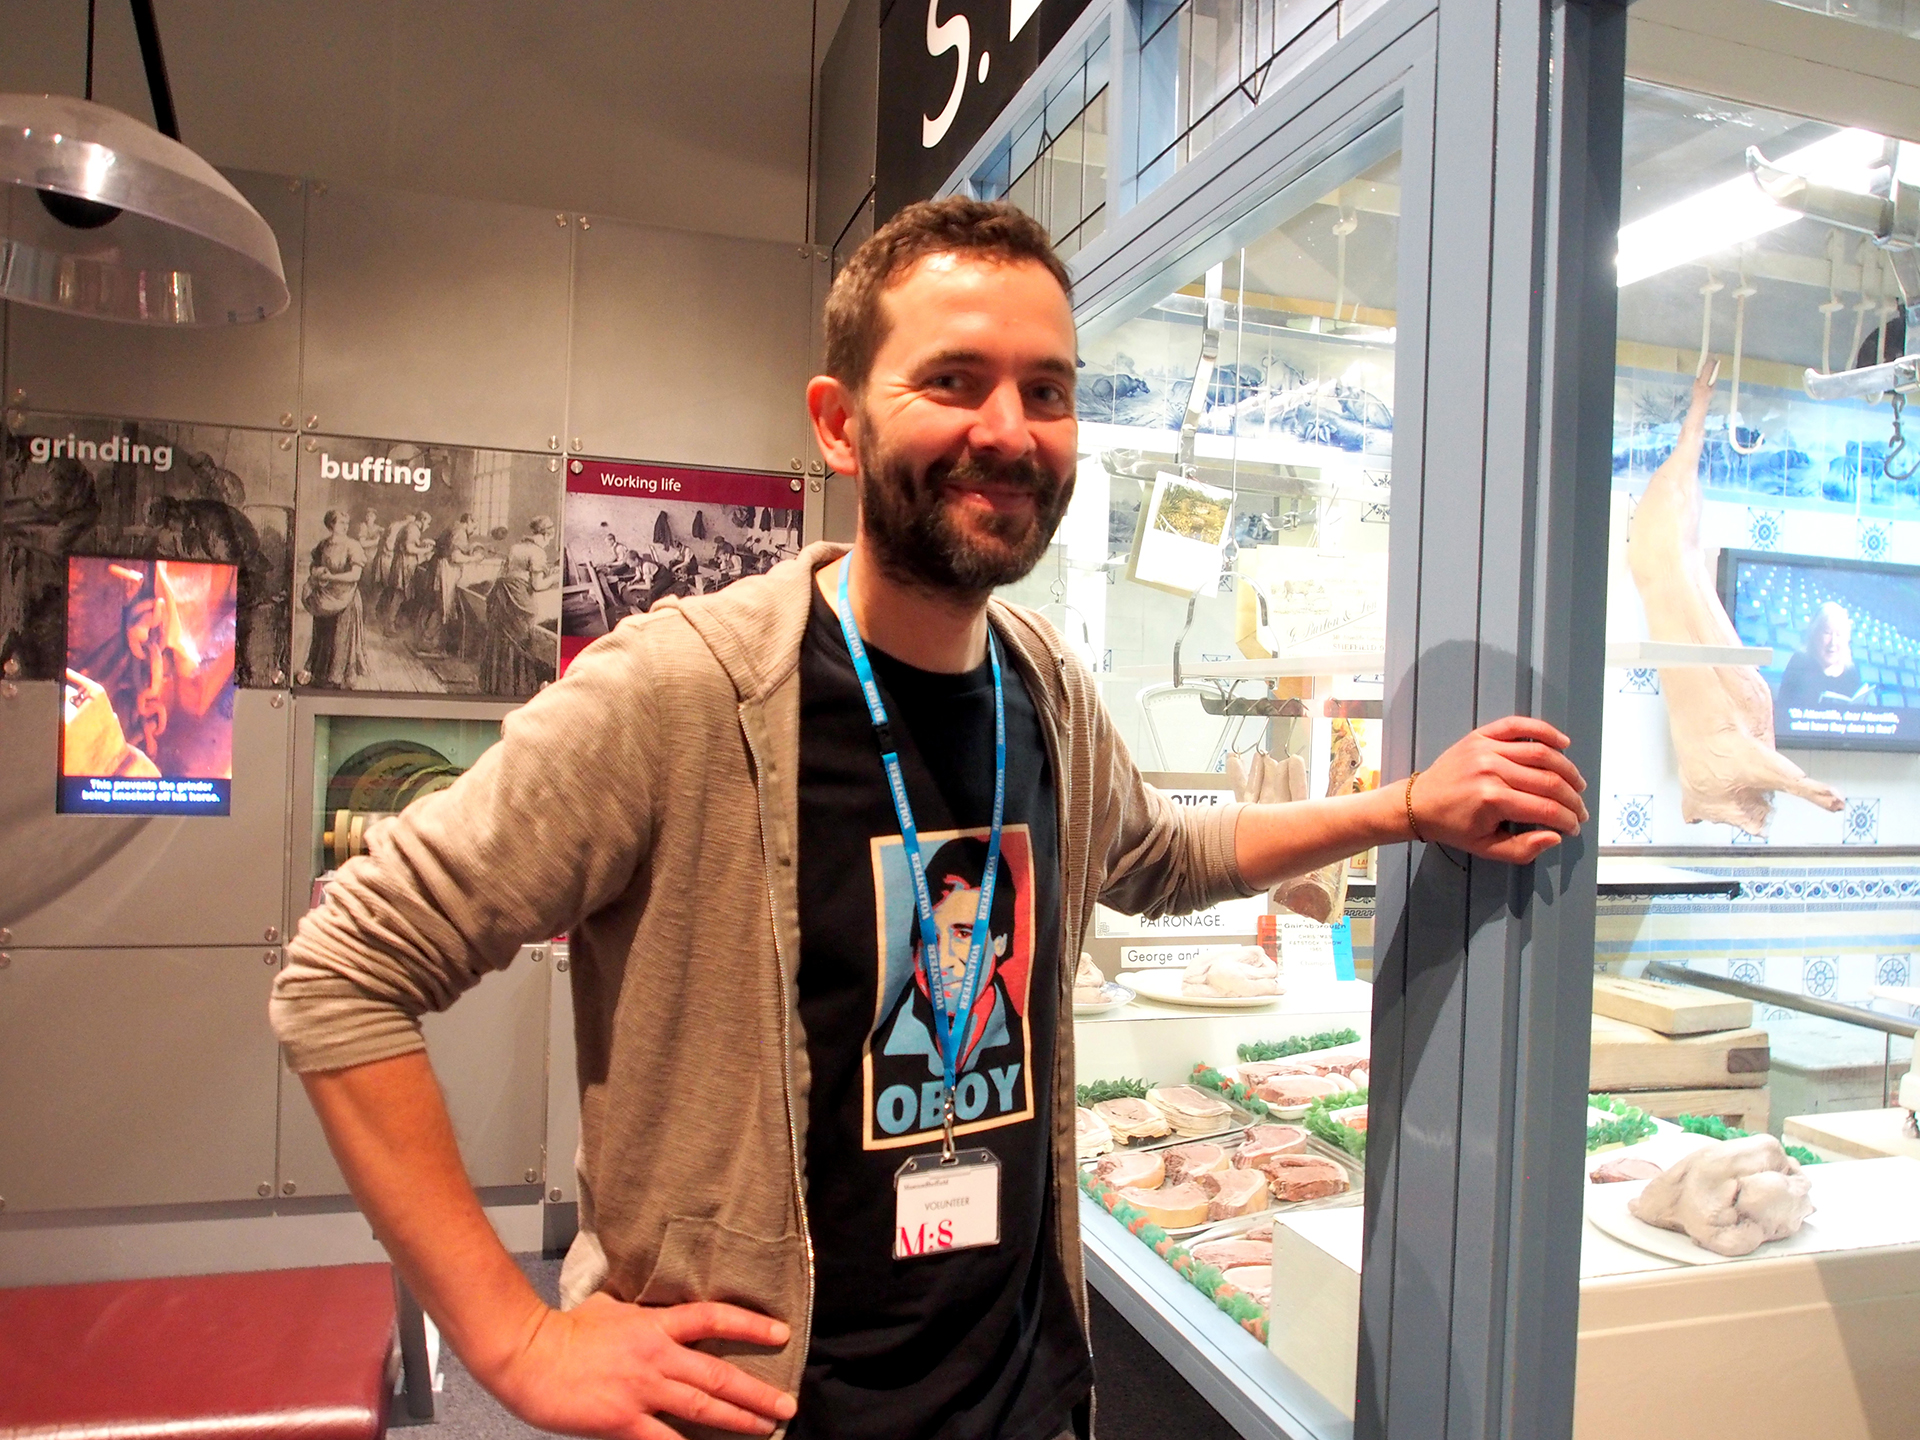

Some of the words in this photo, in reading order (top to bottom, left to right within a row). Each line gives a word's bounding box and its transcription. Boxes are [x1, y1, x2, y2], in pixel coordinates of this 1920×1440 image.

[30, 432, 173, 472] grinding
[320, 453, 432, 493] buffing
[600, 472, 657, 493] Working
[661, 477, 682, 492] life
[82, 790, 112, 803] being
[112, 790, 155, 802] knocked
[156, 790, 171, 802] off
[172, 791, 188, 802] his
[90, 778, 112, 790] This
[113, 780, 158, 792] prevents
[158, 780, 176, 791] the
[176, 781, 213, 793] grinder
[888, 761, 913, 831] VOLUNTEER
[910, 852, 931, 921] VOLUNTEER
[978, 855, 996, 921] VOLUNTEER
[927, 943, 945, 1011] VOLUNTEER
[959, 943, 981, 1010] VOLUNTEER
[1127, 949, 1173, 965] George
[877, 1063, 1021, 1135] OBOY
[924, 1196, 970, 1211] VOLUNTEER
